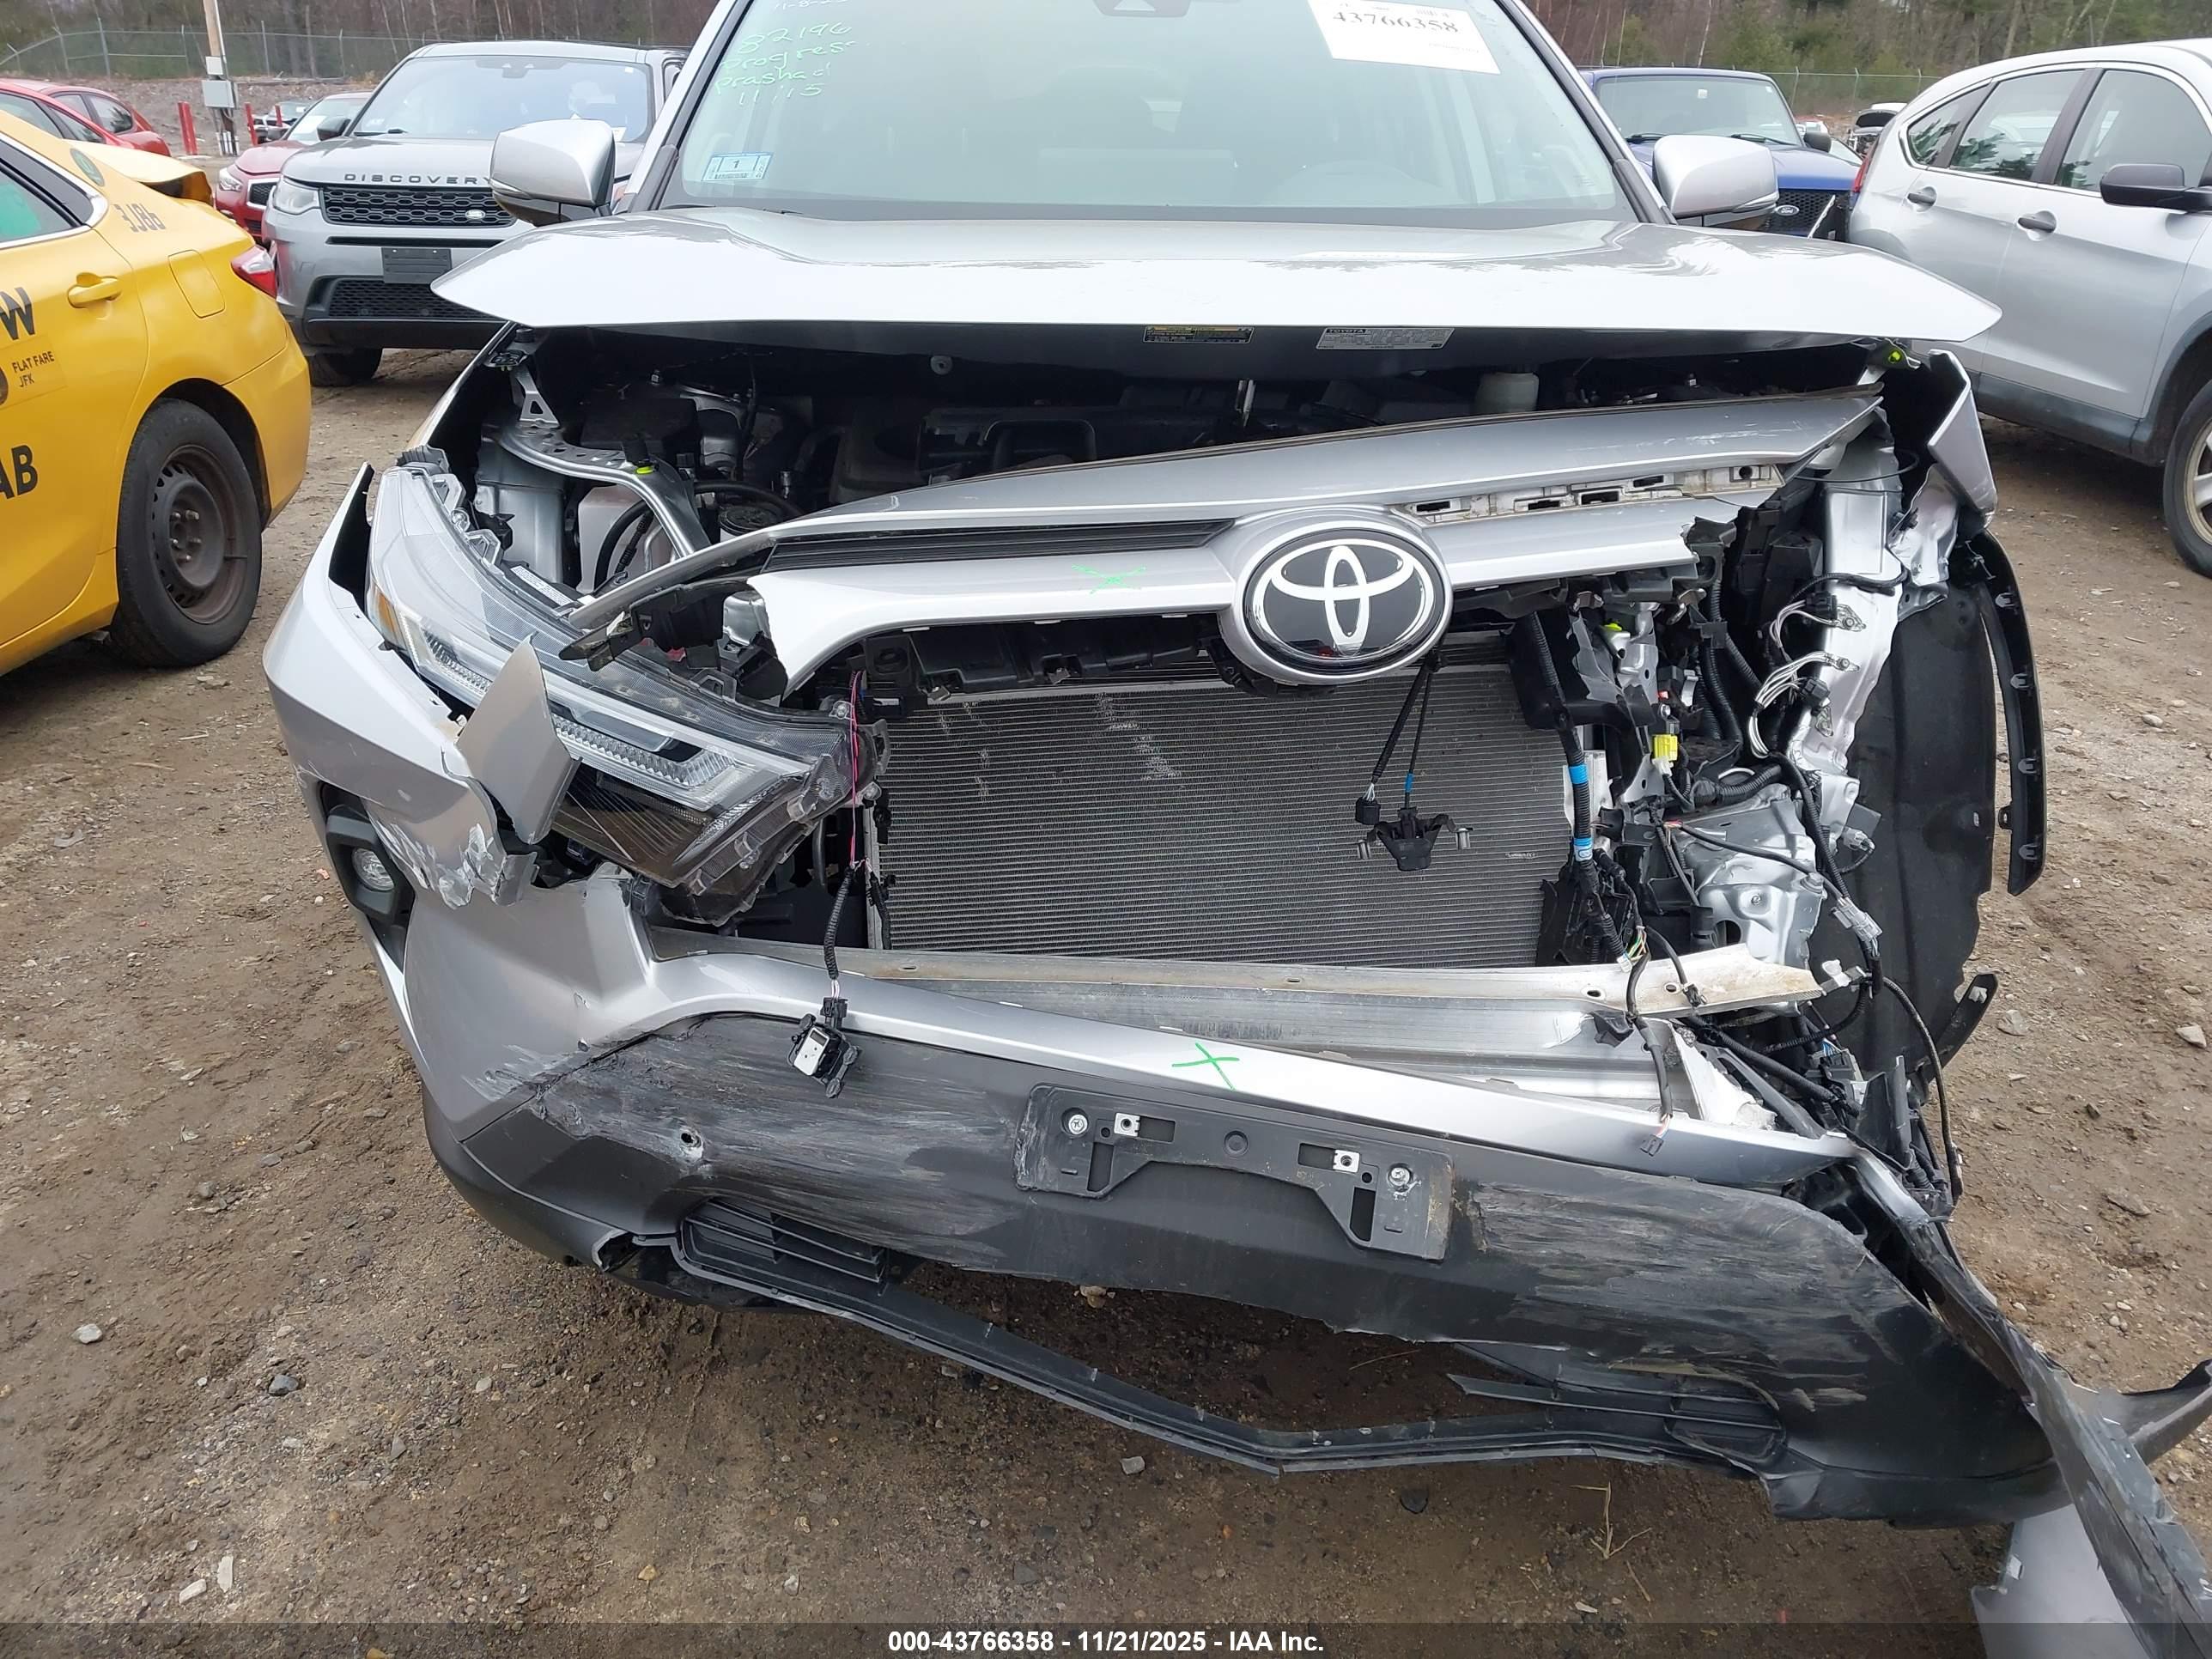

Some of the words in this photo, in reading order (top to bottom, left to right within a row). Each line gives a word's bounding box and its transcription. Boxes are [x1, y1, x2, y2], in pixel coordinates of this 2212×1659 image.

[1333, 11, 1458, 33] 43766358
[738, 22, 852, 54] 82196
[12, 358, 33, 374] FLAT
[33, 351, 55, 365] FARE
[19, 374, 35, 388] JFK
